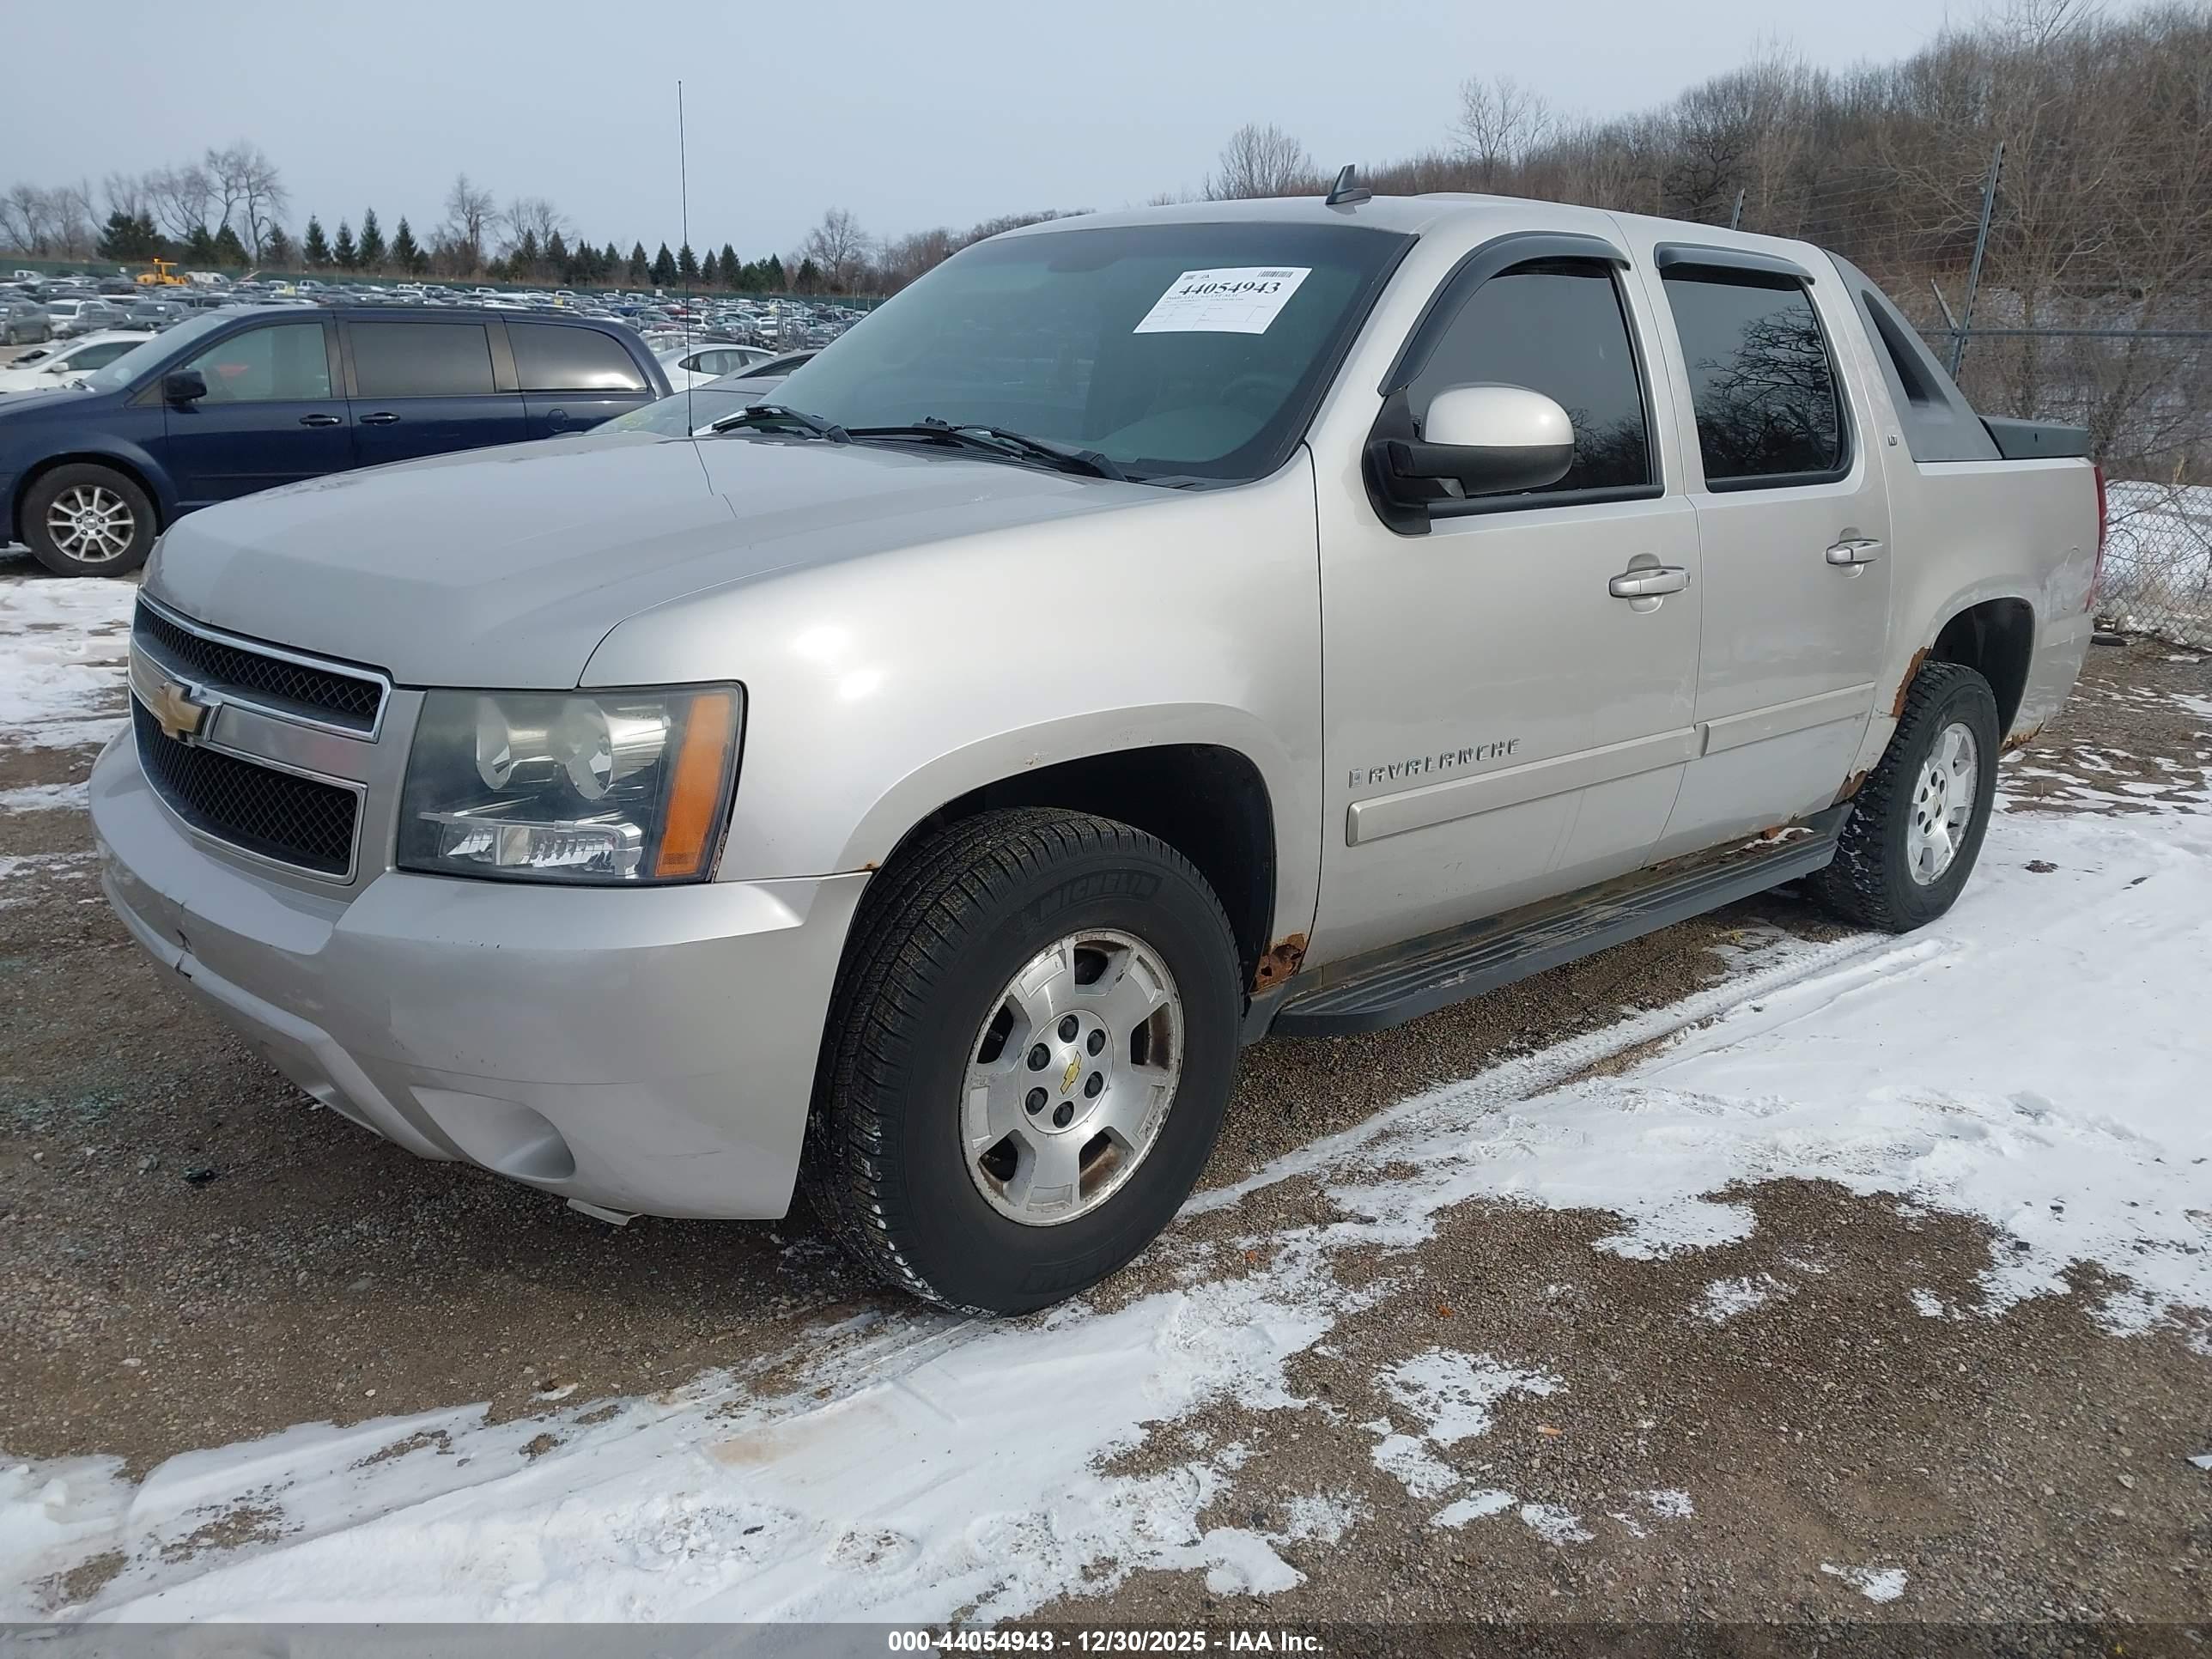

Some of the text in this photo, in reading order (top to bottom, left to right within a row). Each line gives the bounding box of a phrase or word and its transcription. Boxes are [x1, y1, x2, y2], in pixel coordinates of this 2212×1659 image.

[1179, 281, 1281, 295] 44054943
[1369, 738, 1520, 784] AVALANCHE
[1039, 872, 1161, 921] MICHELIN
